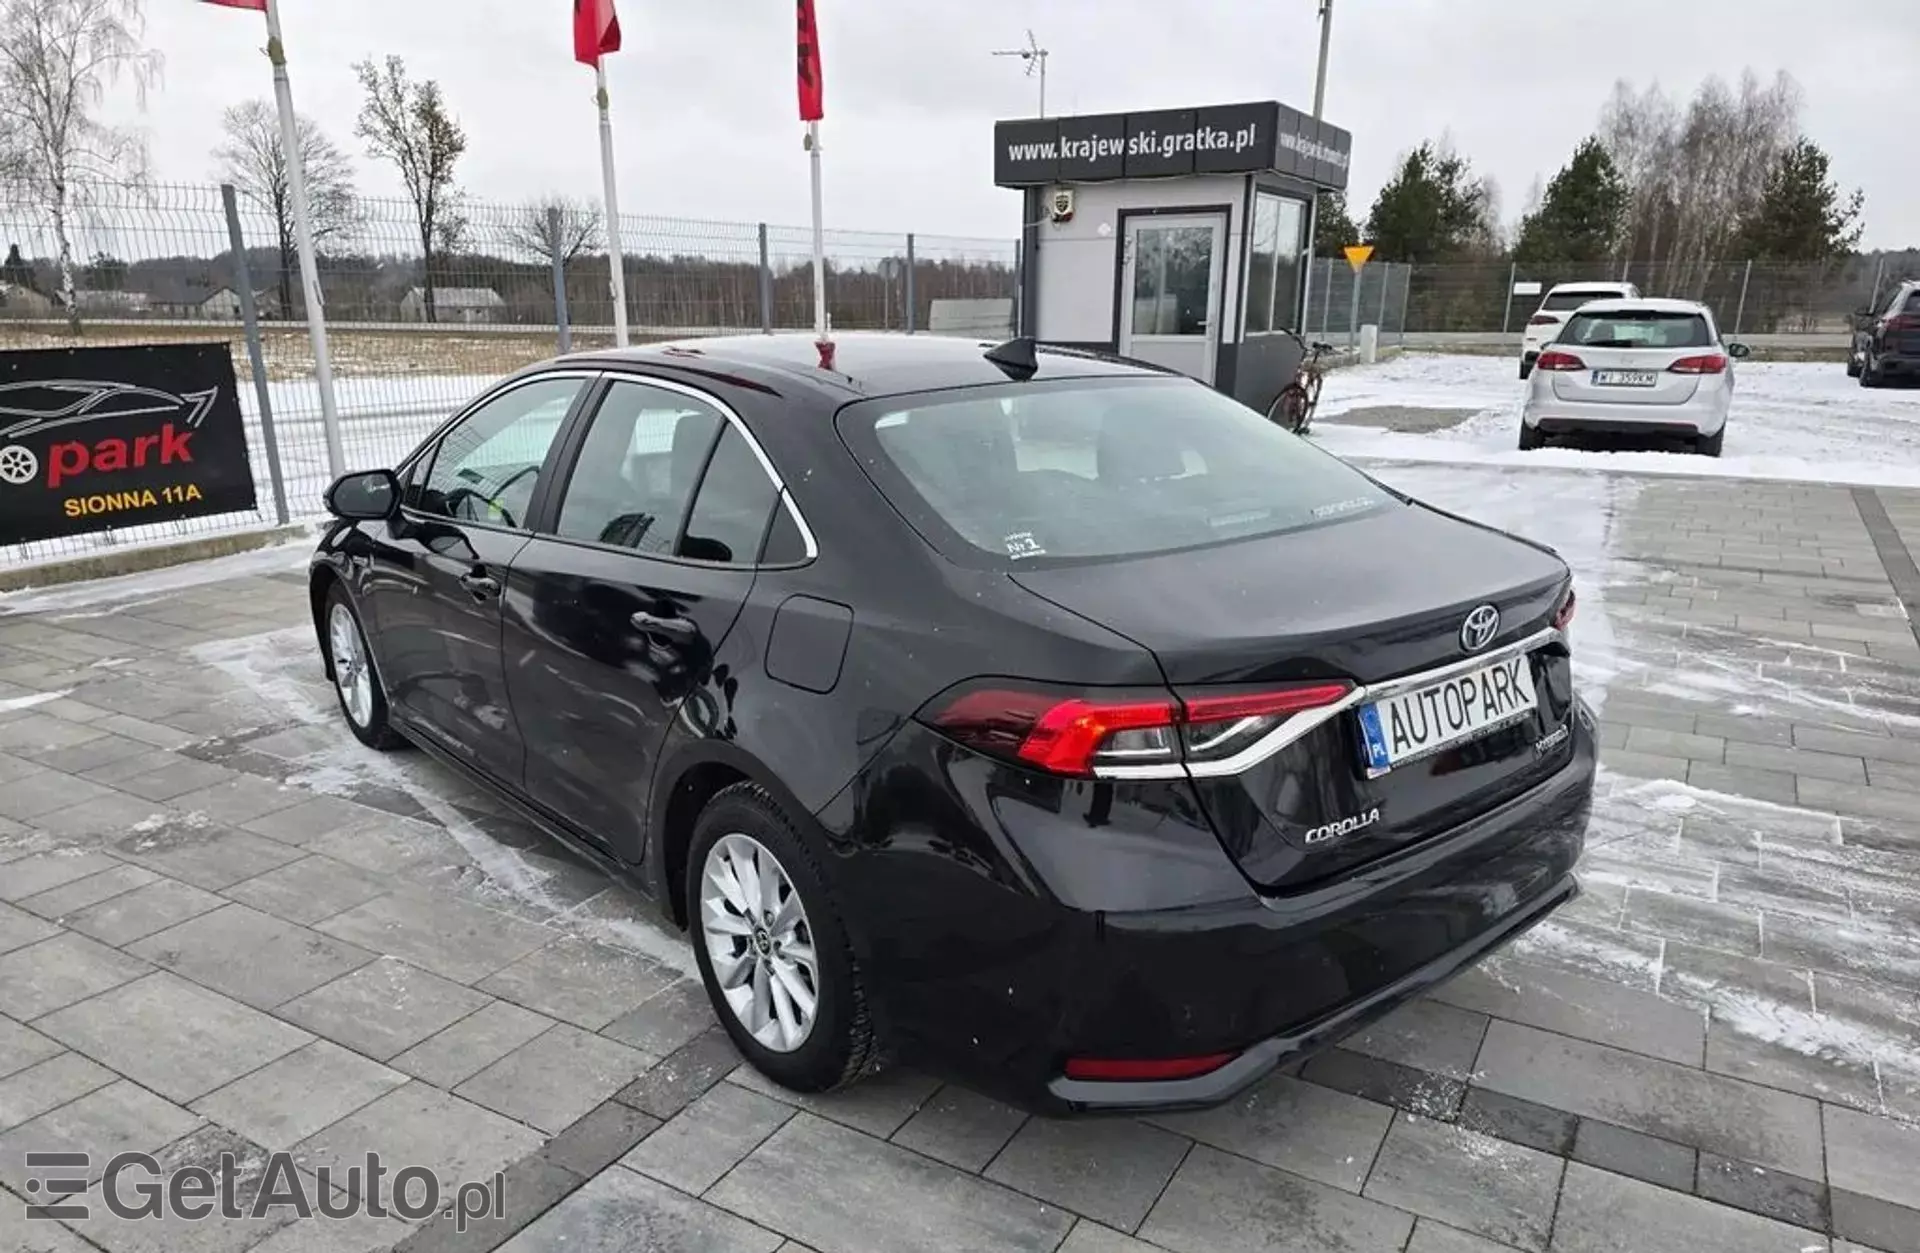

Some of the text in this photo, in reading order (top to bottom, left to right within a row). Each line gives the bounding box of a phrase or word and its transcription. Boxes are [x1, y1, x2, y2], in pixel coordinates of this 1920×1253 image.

[48, 424, 193, 488] park
[64, 483, 203, 517] SIONNA 11A
[1389, 659, 1530, 755] AUTOPARK
[1371, 740, 1387, 757] PL
[1305, 808, 1380, 844] COROLLA
